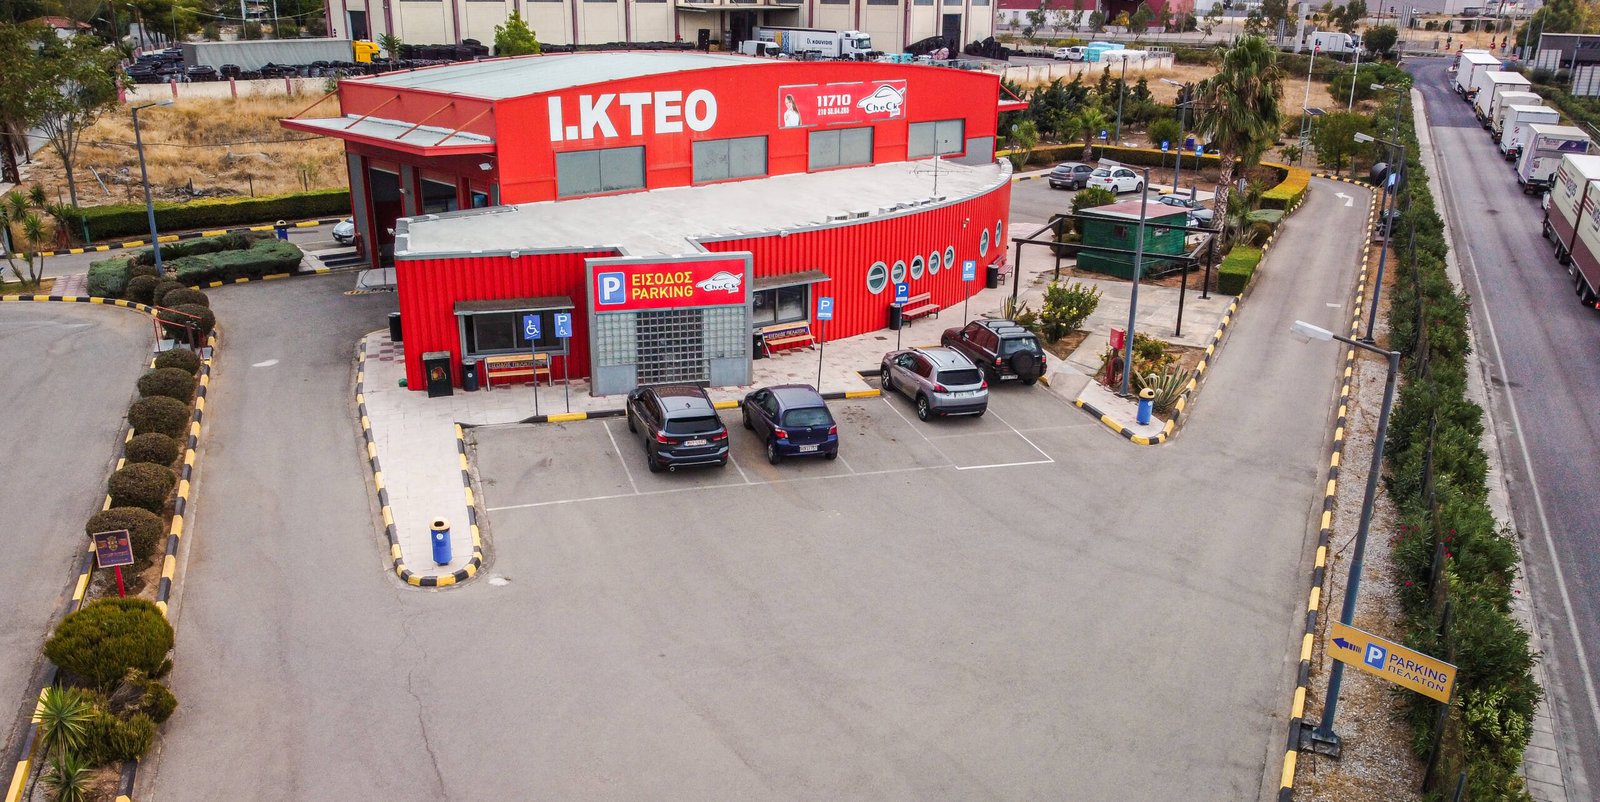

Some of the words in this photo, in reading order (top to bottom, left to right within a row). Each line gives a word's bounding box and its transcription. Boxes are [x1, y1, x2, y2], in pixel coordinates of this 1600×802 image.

[817, 94, 851, 107] 11710
[966, 262, 973, 271] P
[631, 271, 693, 286] ΕΙΣΟΔΟΣ
[603, 277, 621, 301] P
[632, 285, 693, 300] PARKING
[898, 285, 906, 295] P
[821, 300, 830, 310] P
[558, 315, 567, 326] P
[1368, 646, 1383, 663] P
[1389, 653, 1448, 684] PARKING
[1388, 665, 1445, 692] ΠΕΛΑΤΩΝ
